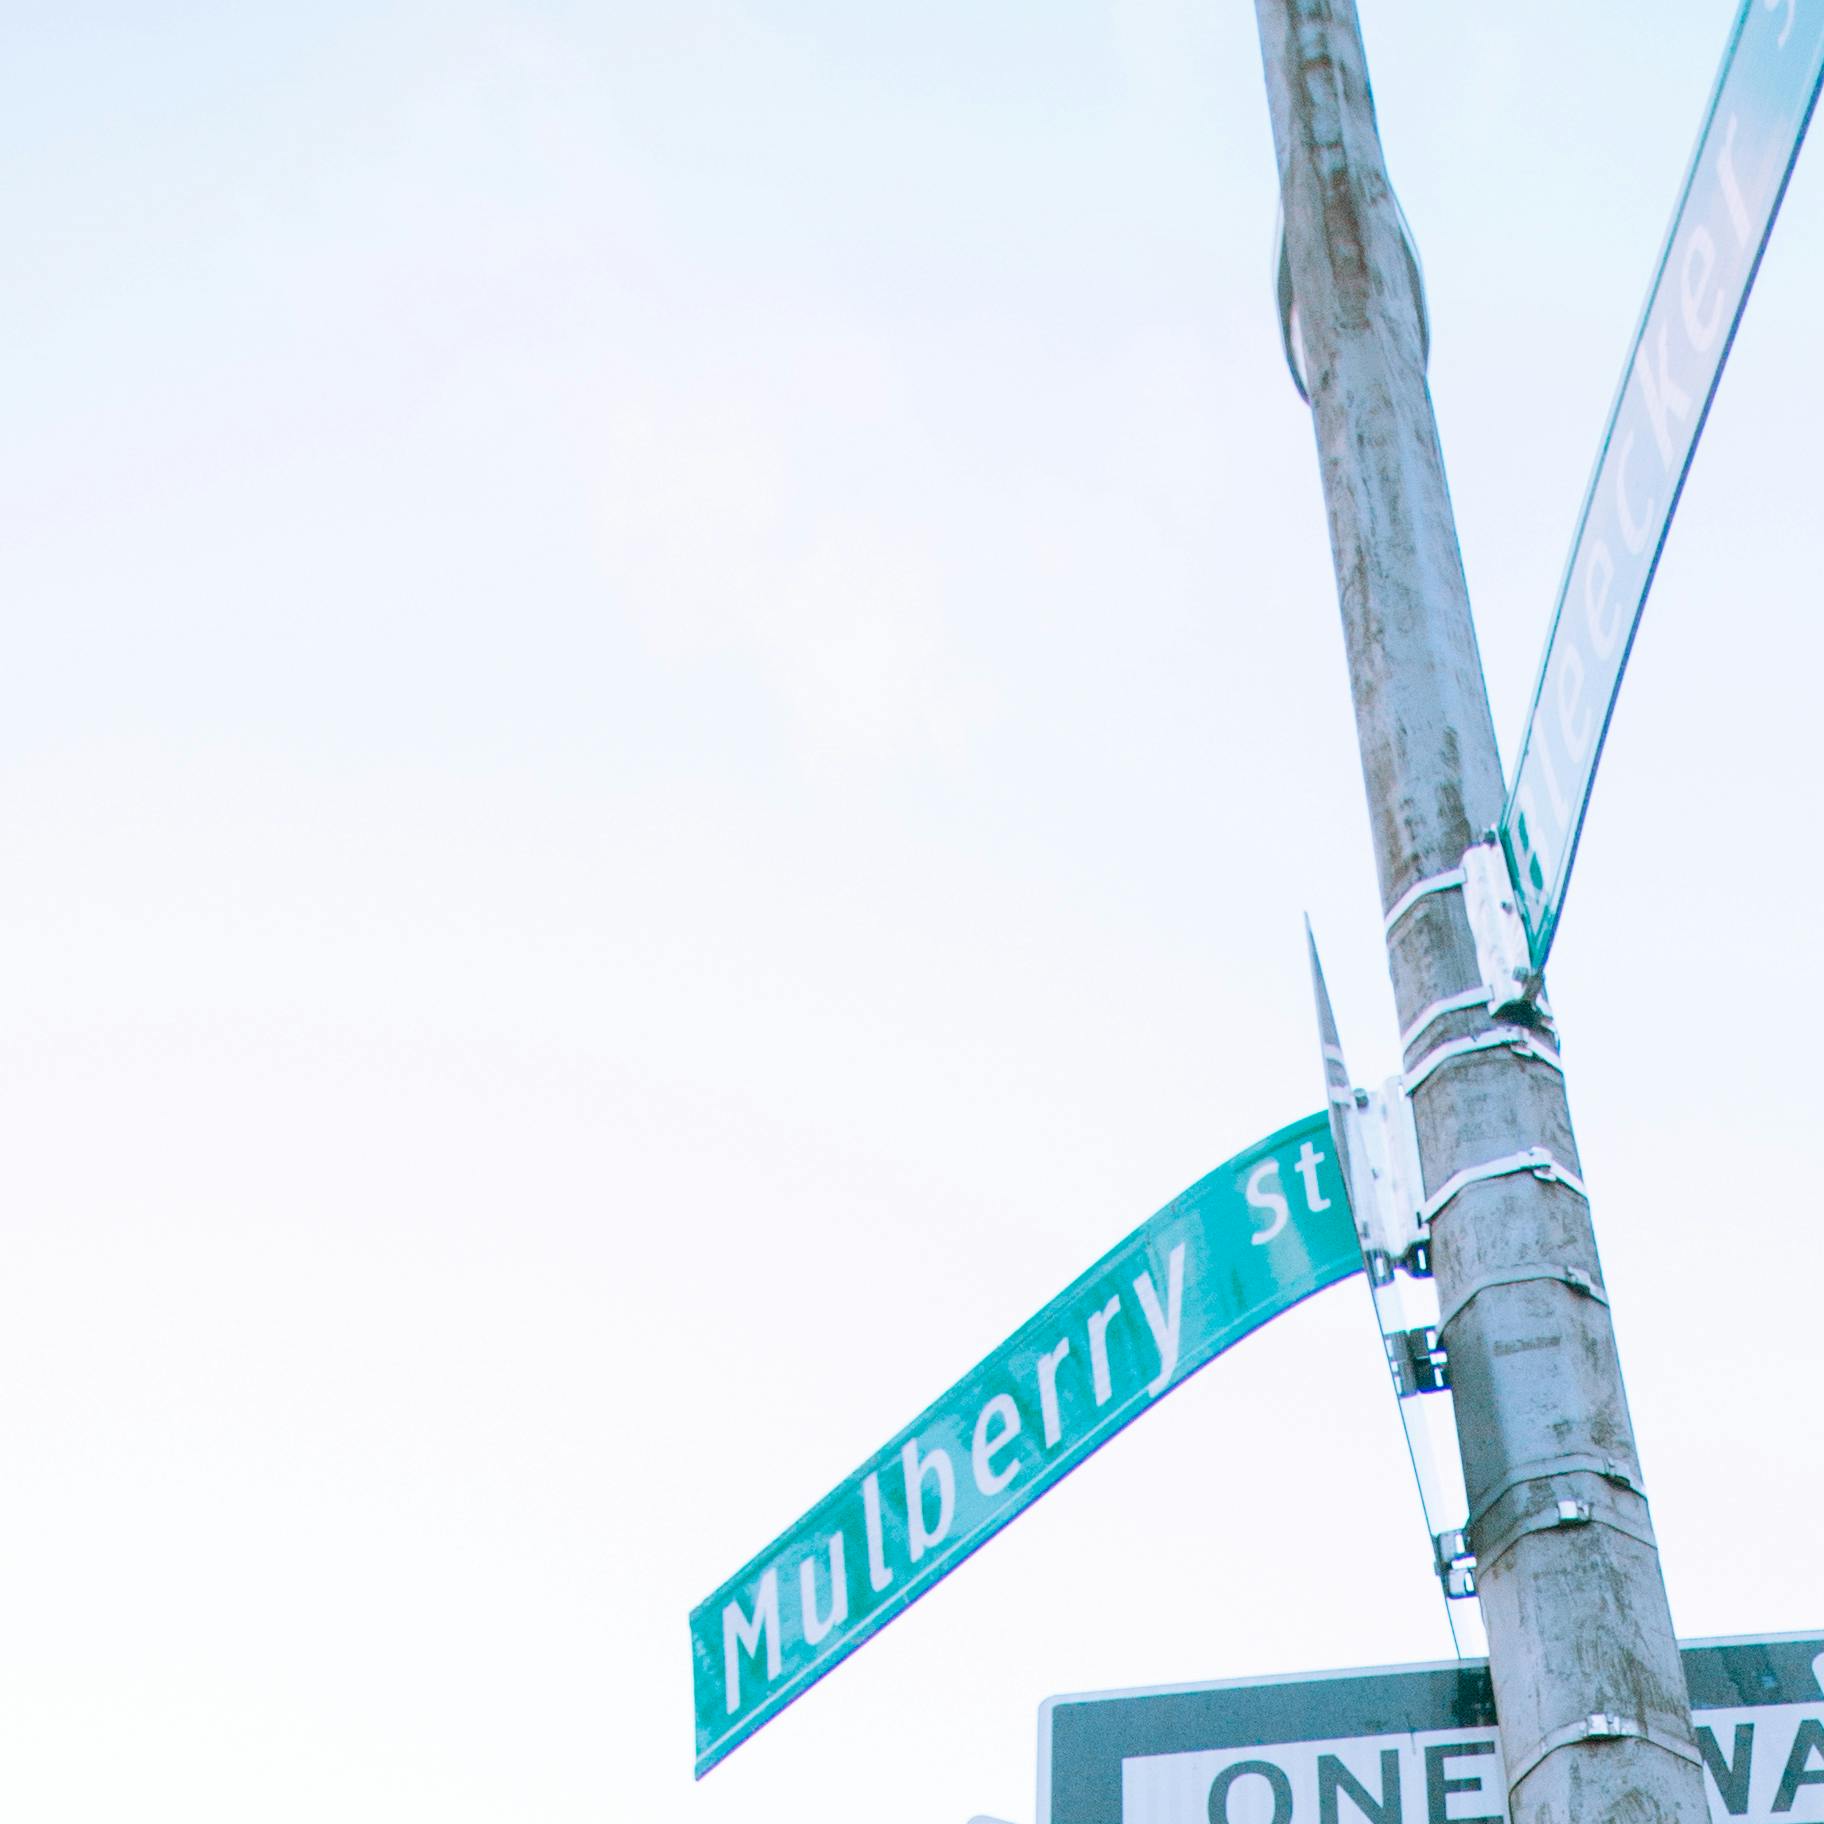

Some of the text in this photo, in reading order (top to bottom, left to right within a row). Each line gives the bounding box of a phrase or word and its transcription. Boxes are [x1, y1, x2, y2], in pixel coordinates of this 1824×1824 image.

[1512, 110, 1757, 900] Bleecker
[722, 1141, 1332, 1714] Mulberry St
